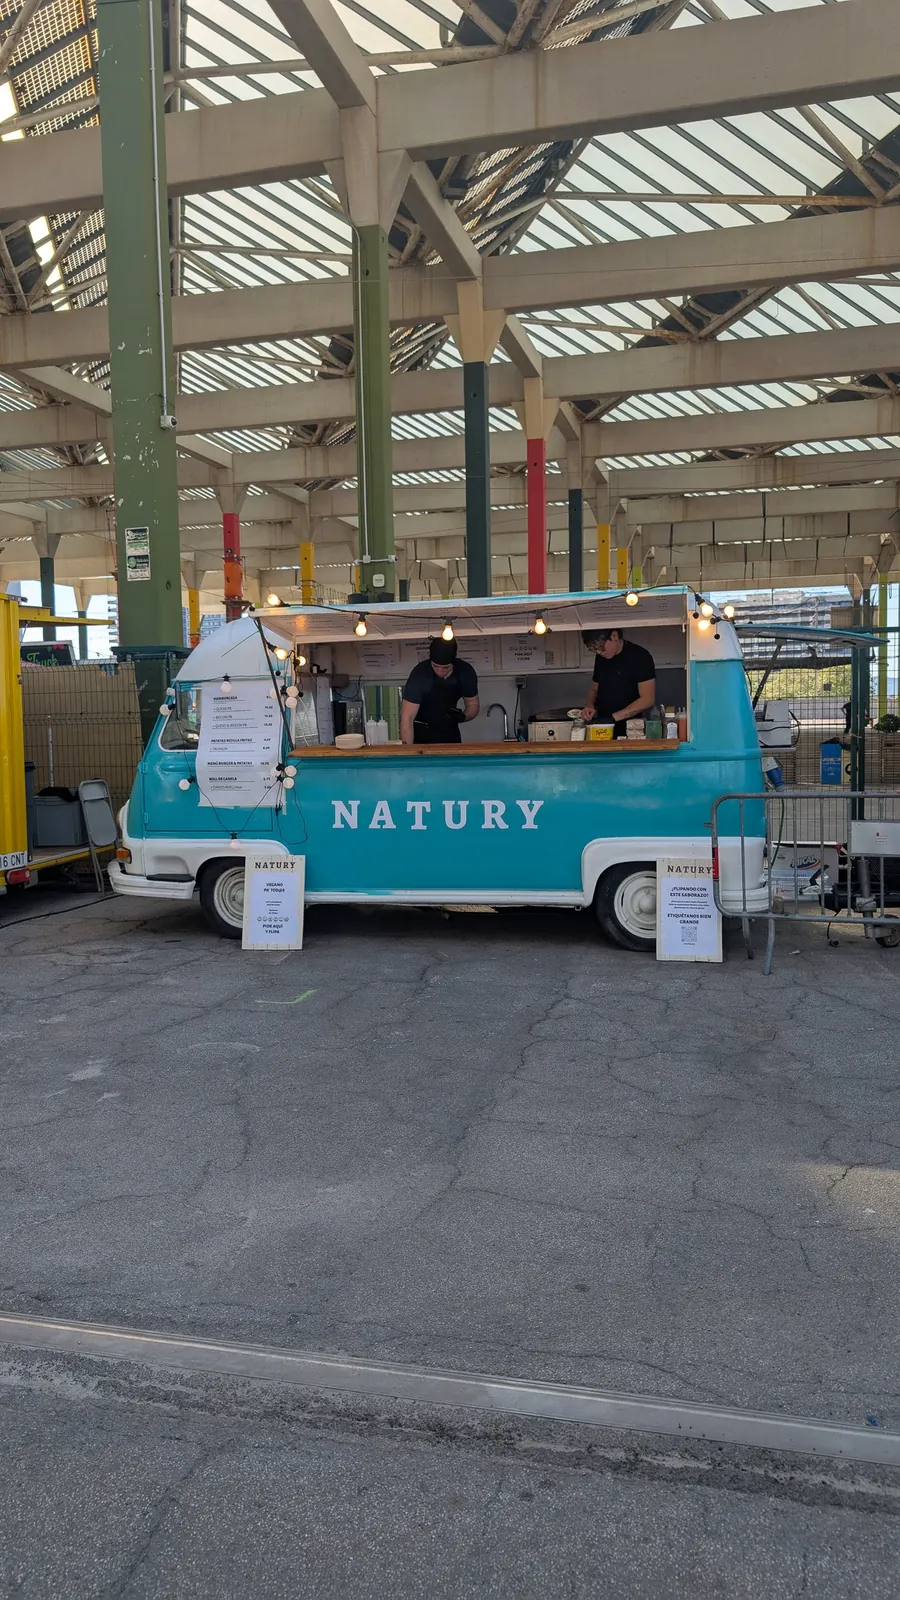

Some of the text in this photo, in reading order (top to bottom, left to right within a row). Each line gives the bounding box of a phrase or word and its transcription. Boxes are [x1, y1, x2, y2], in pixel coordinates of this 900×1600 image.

[331, 800, 544, 830] NATURY
[11, 852, 24, 866] CNT
[667, 865, 712, 874] NATURY
